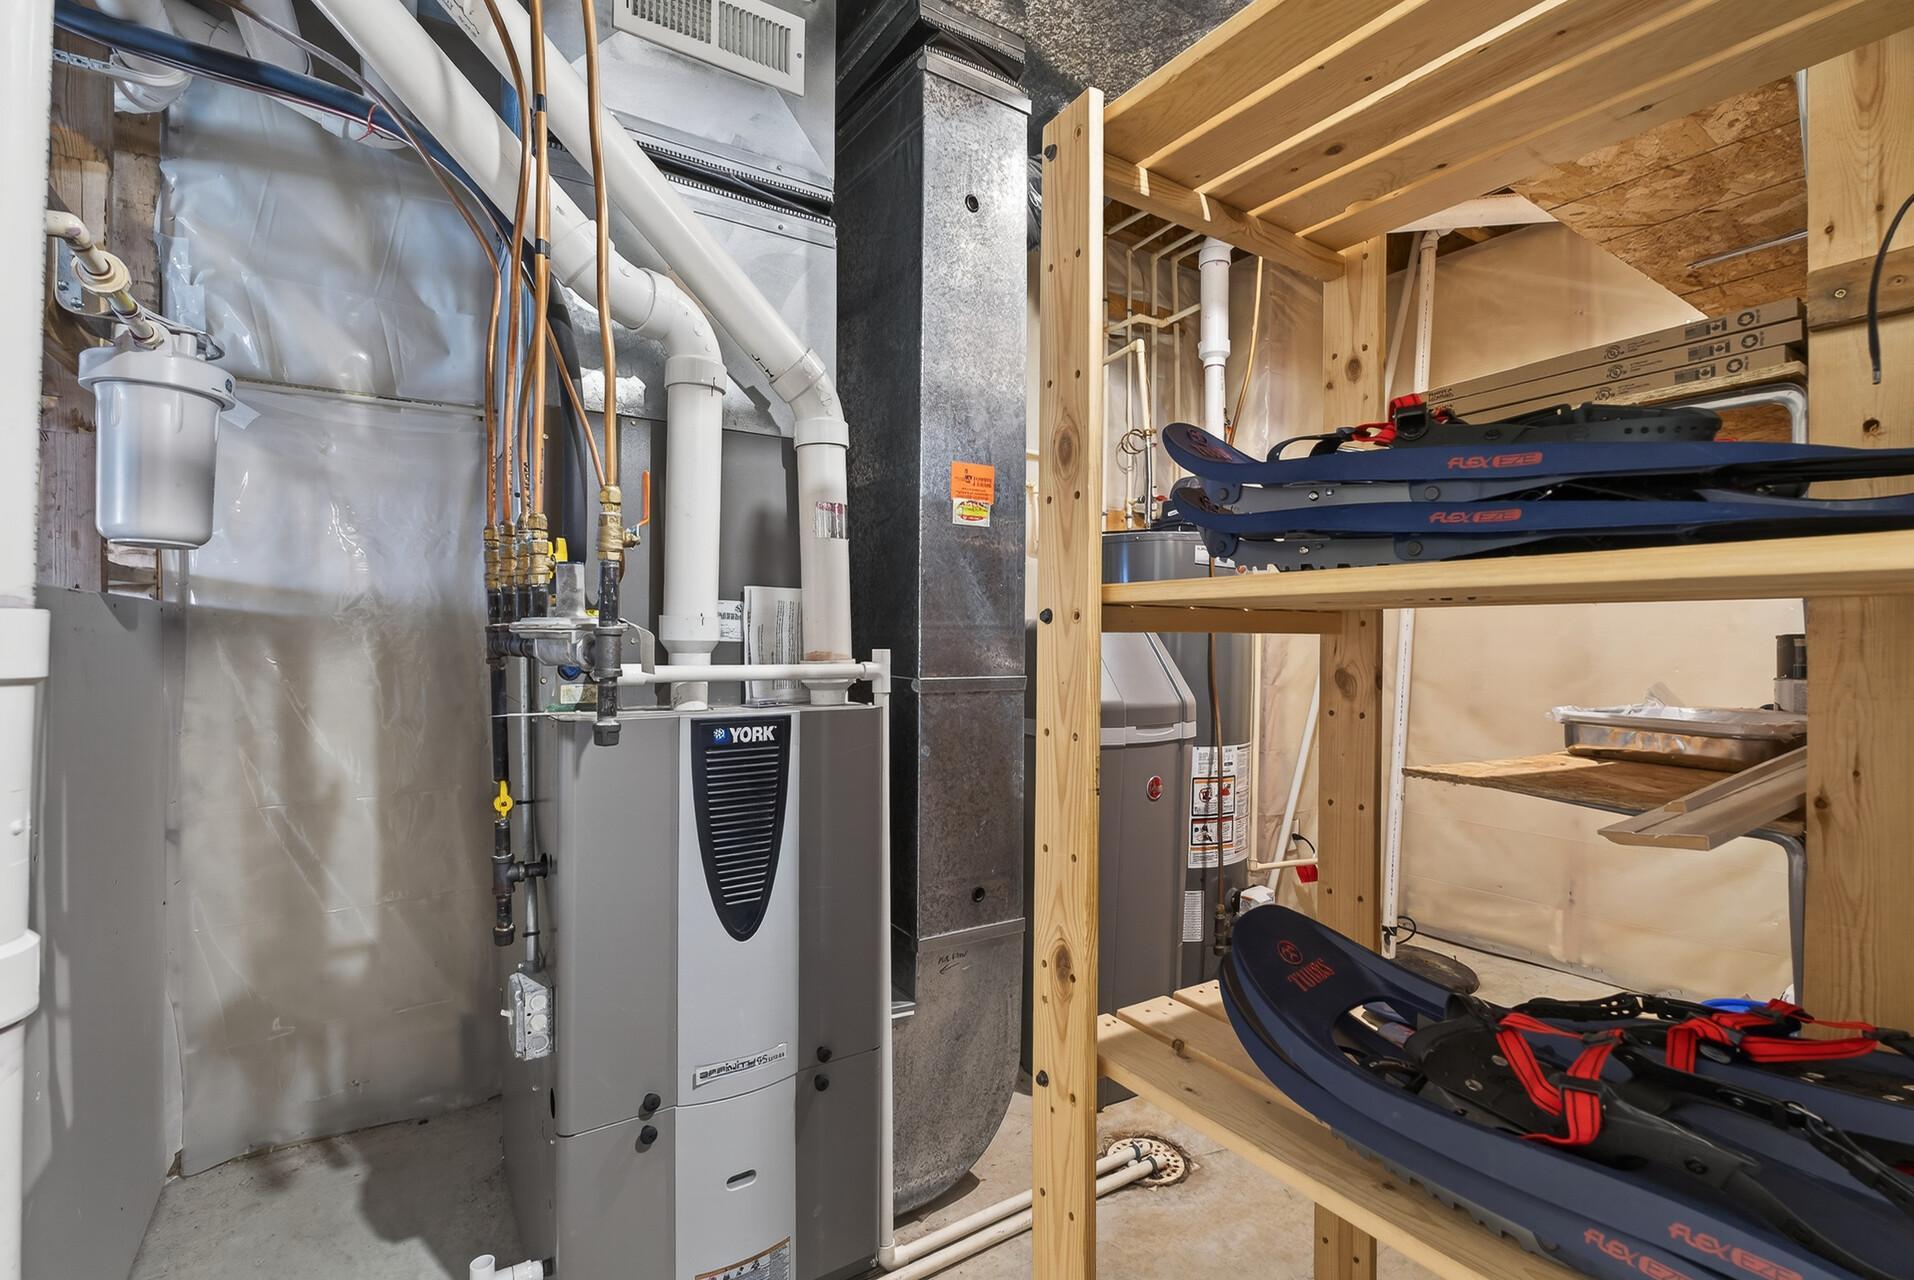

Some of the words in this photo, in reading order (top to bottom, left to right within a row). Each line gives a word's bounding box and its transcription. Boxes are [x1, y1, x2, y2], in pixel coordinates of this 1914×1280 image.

[1447, 456, 1491, 470] FLEX
[1429, 512, 1473, 524] FLEX
[729, 725, 775, 743] YORK
[1583, 1227, 1637, 1268] FLEX
[1667, 1220, 1732, 1262] FLEX
